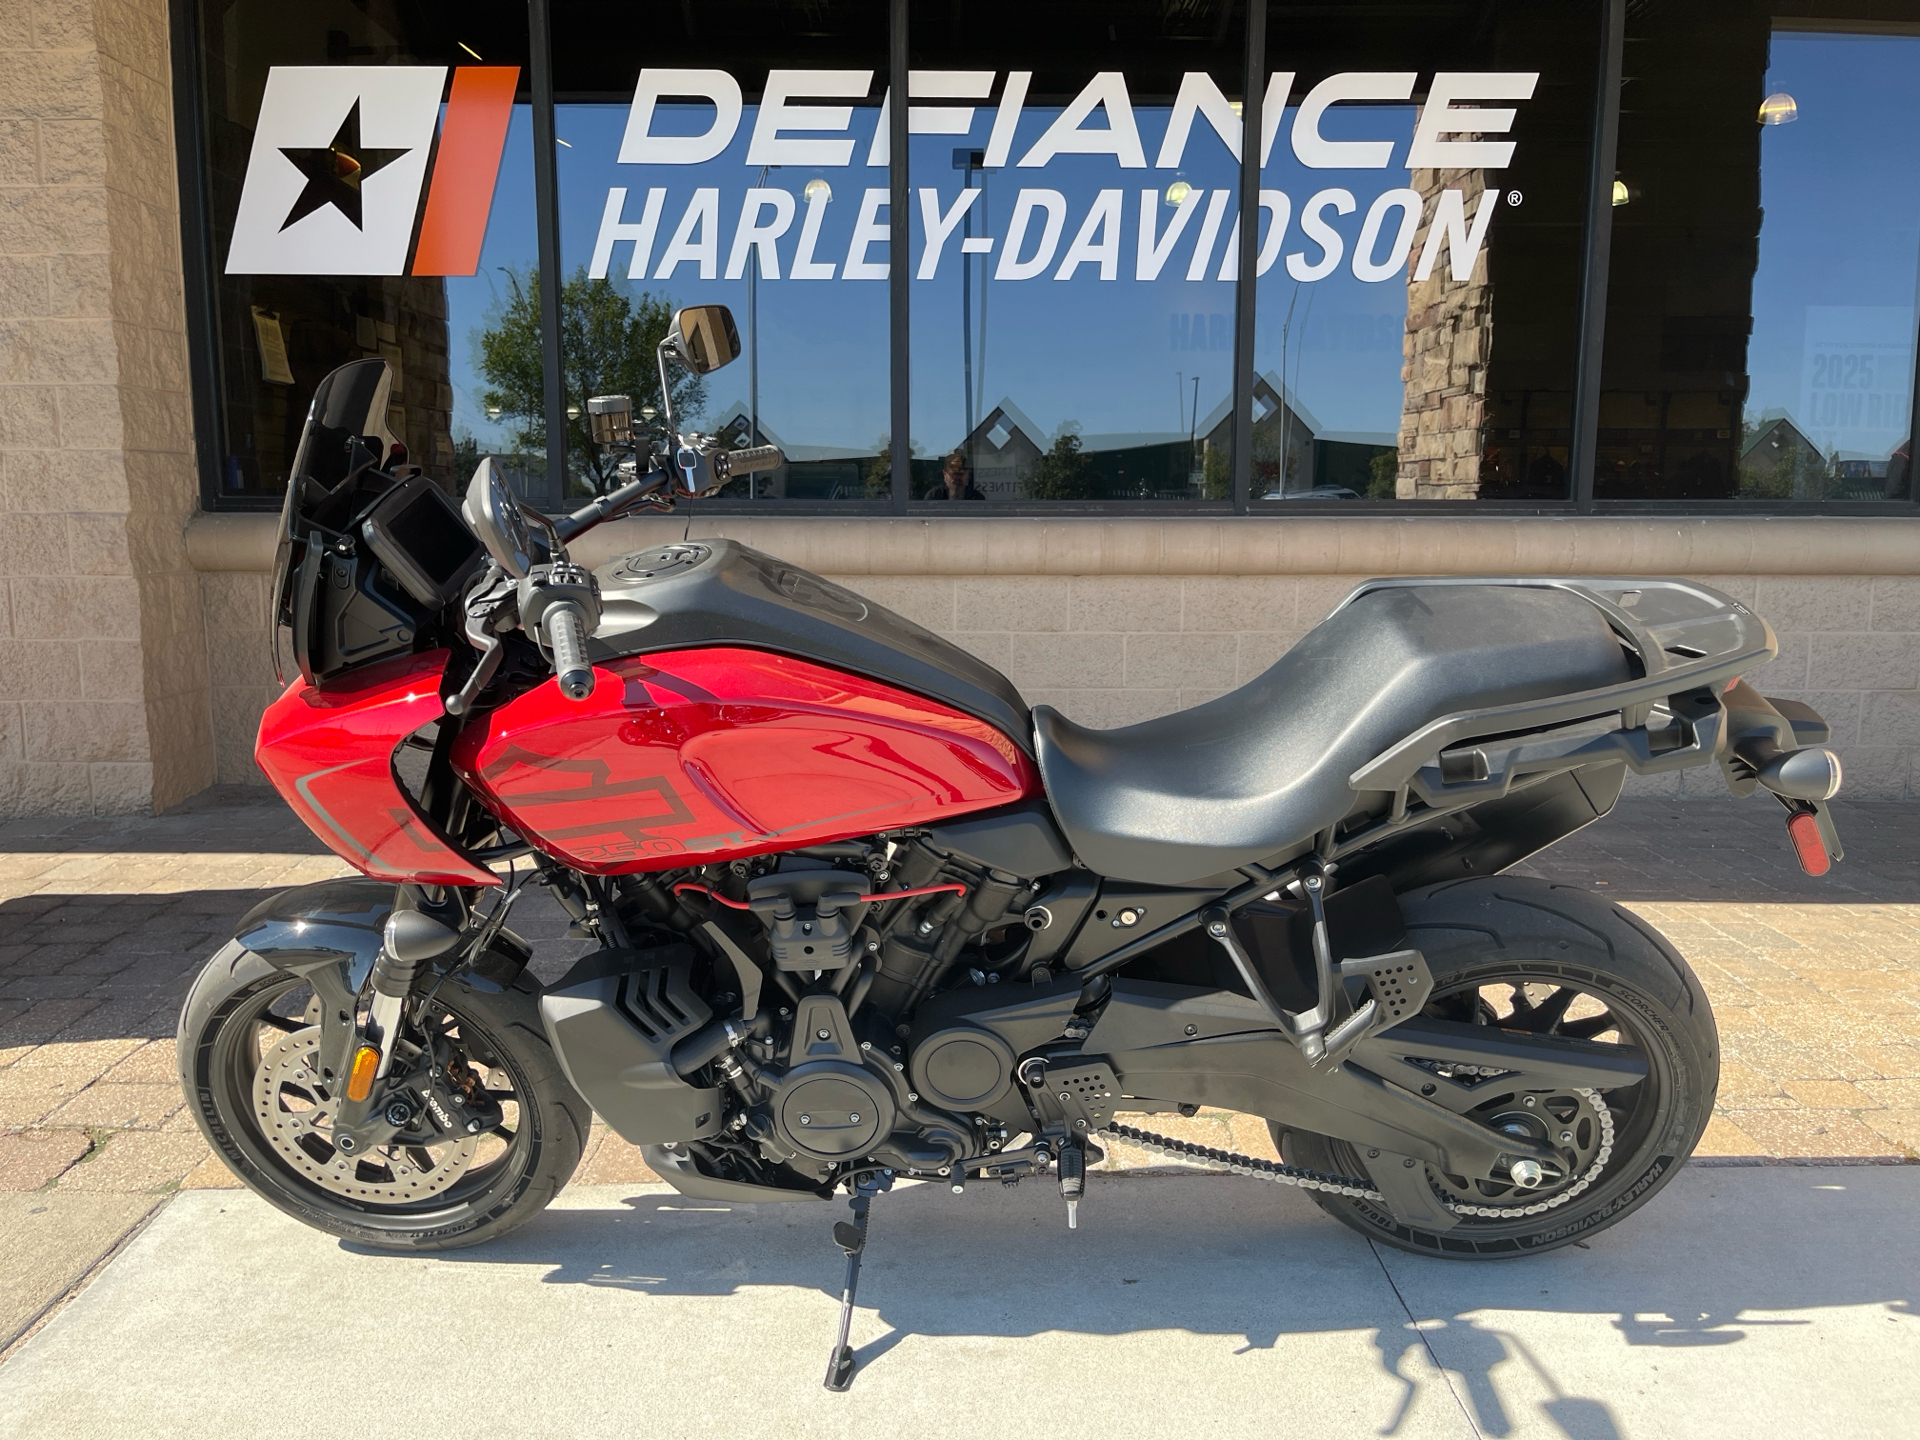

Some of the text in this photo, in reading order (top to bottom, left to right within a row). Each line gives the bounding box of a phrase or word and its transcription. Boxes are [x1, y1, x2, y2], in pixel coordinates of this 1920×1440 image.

[617, 68, 1539, 169] DEFIANCE
[1812, 353, 1874, 389] 2025
[1809, 392, 1863, 428] LOW
[1616, 988, 1670, 1036] SCORCHER
[199, 1090, 243, 1163] MICHELIN
[1352, 1199, 1393, 1229] 180/55
[1530, 1162, 1664, 1247] HARLEY-DAVIDSON
